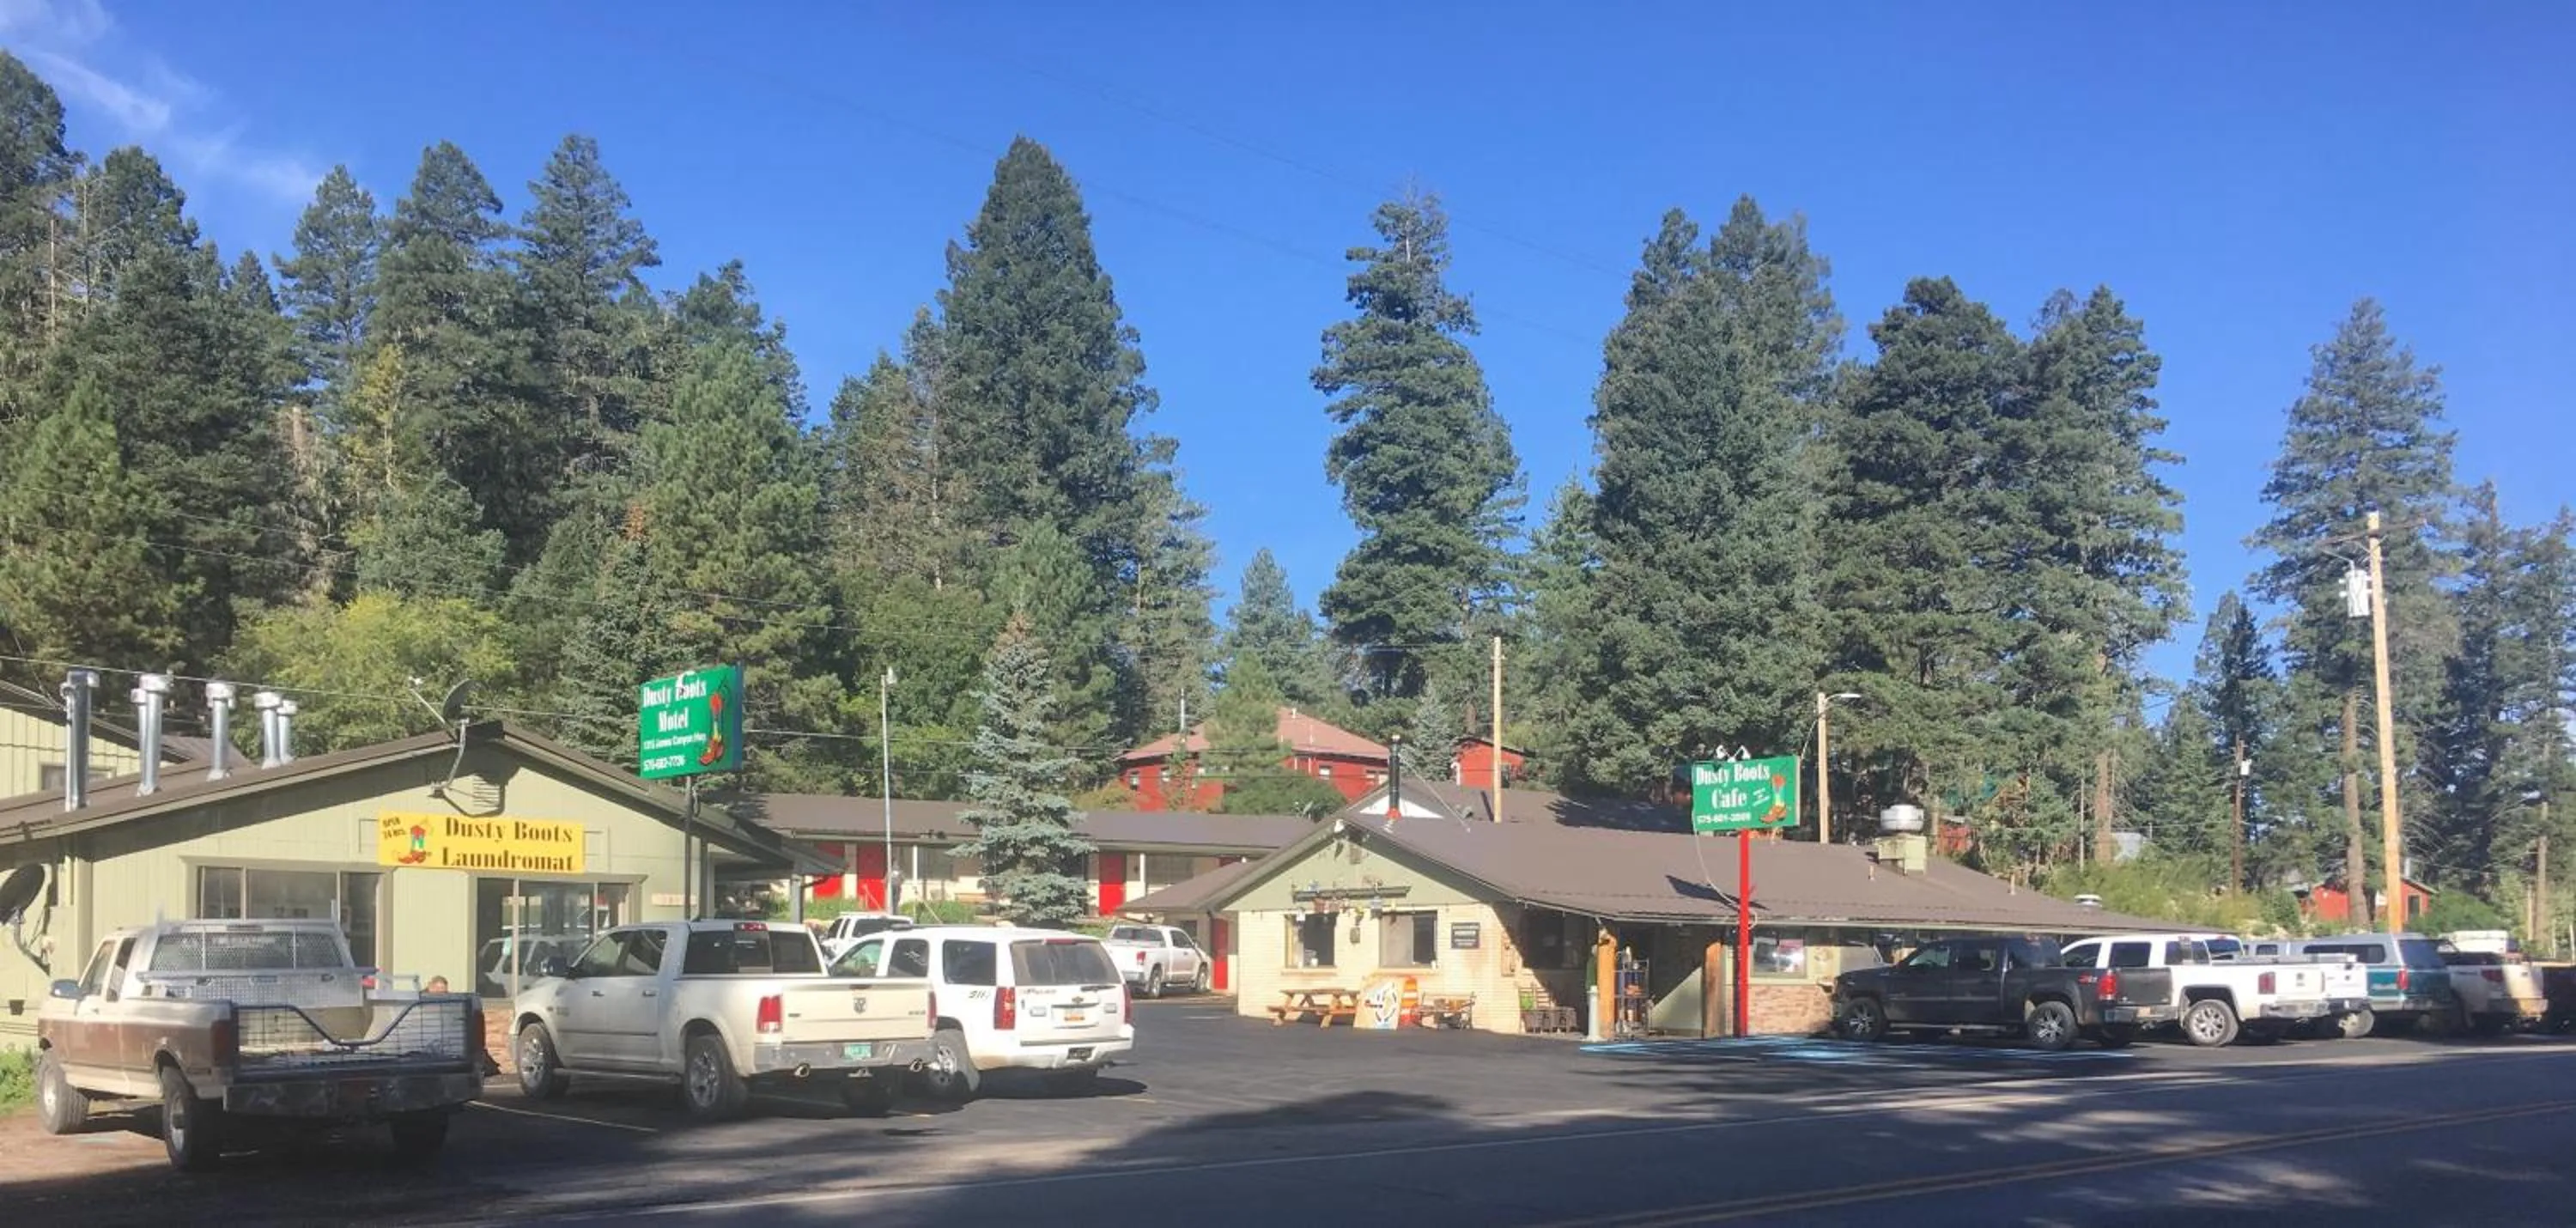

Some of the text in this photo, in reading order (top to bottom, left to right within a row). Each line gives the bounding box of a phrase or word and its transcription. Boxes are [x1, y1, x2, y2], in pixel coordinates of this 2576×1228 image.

[643, 686, 671, 708] Dusty
[659, 707, 689, 733] Motel
[1696, 763, 1770, 787] Dusty Boots
[1711, 787, 1747, 809] Cafe
[383, 817, 401, 827] OPEN
[446, 817, 573, 843] Dusty Boots
[442, 847, 573, 871] Laundromat
